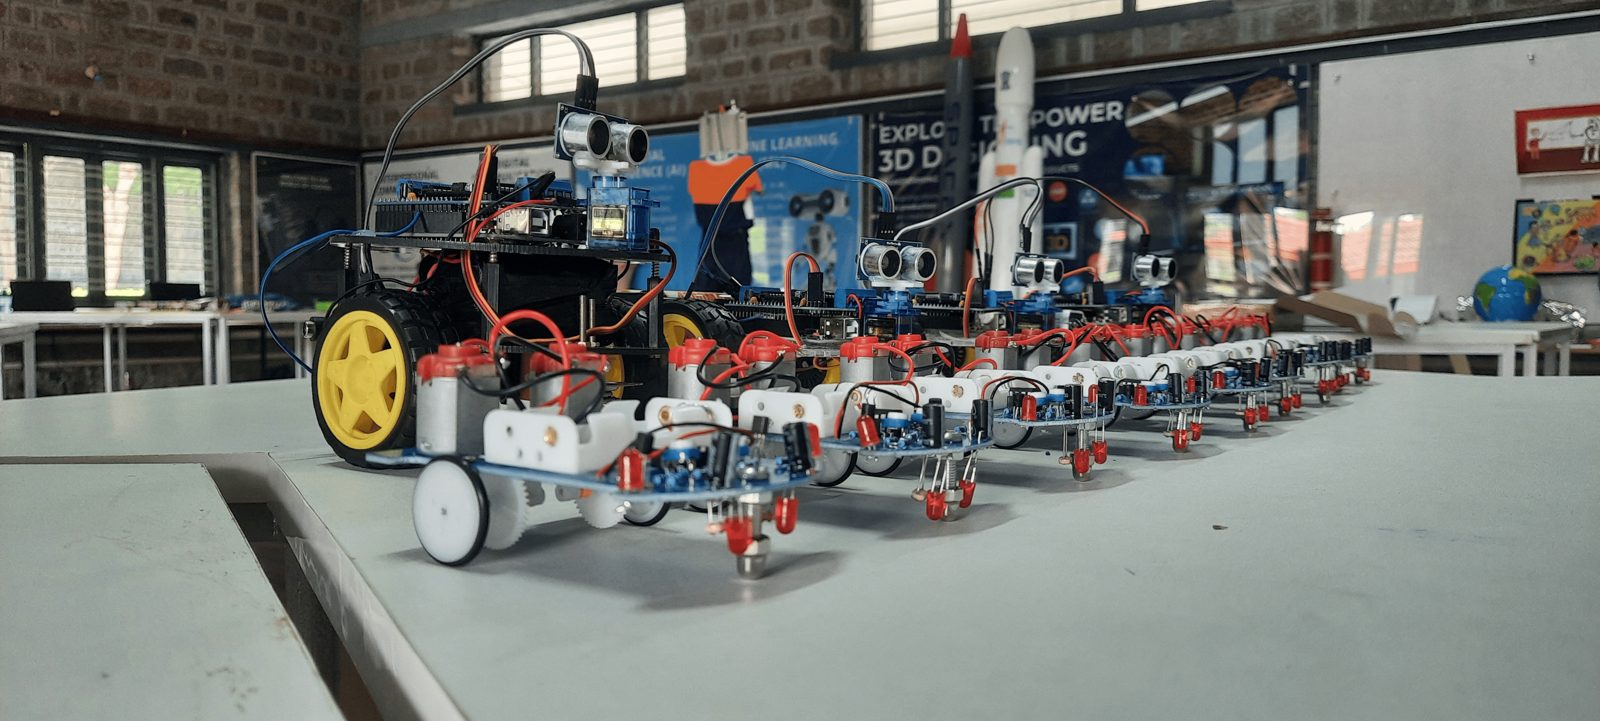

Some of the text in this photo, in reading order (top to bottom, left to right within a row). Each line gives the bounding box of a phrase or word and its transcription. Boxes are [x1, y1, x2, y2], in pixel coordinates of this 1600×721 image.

[1031, 100, 1124, 128] POWER
[770, 132, 839, 151] LEARNING
[878, 148, 915, 172] 3D
